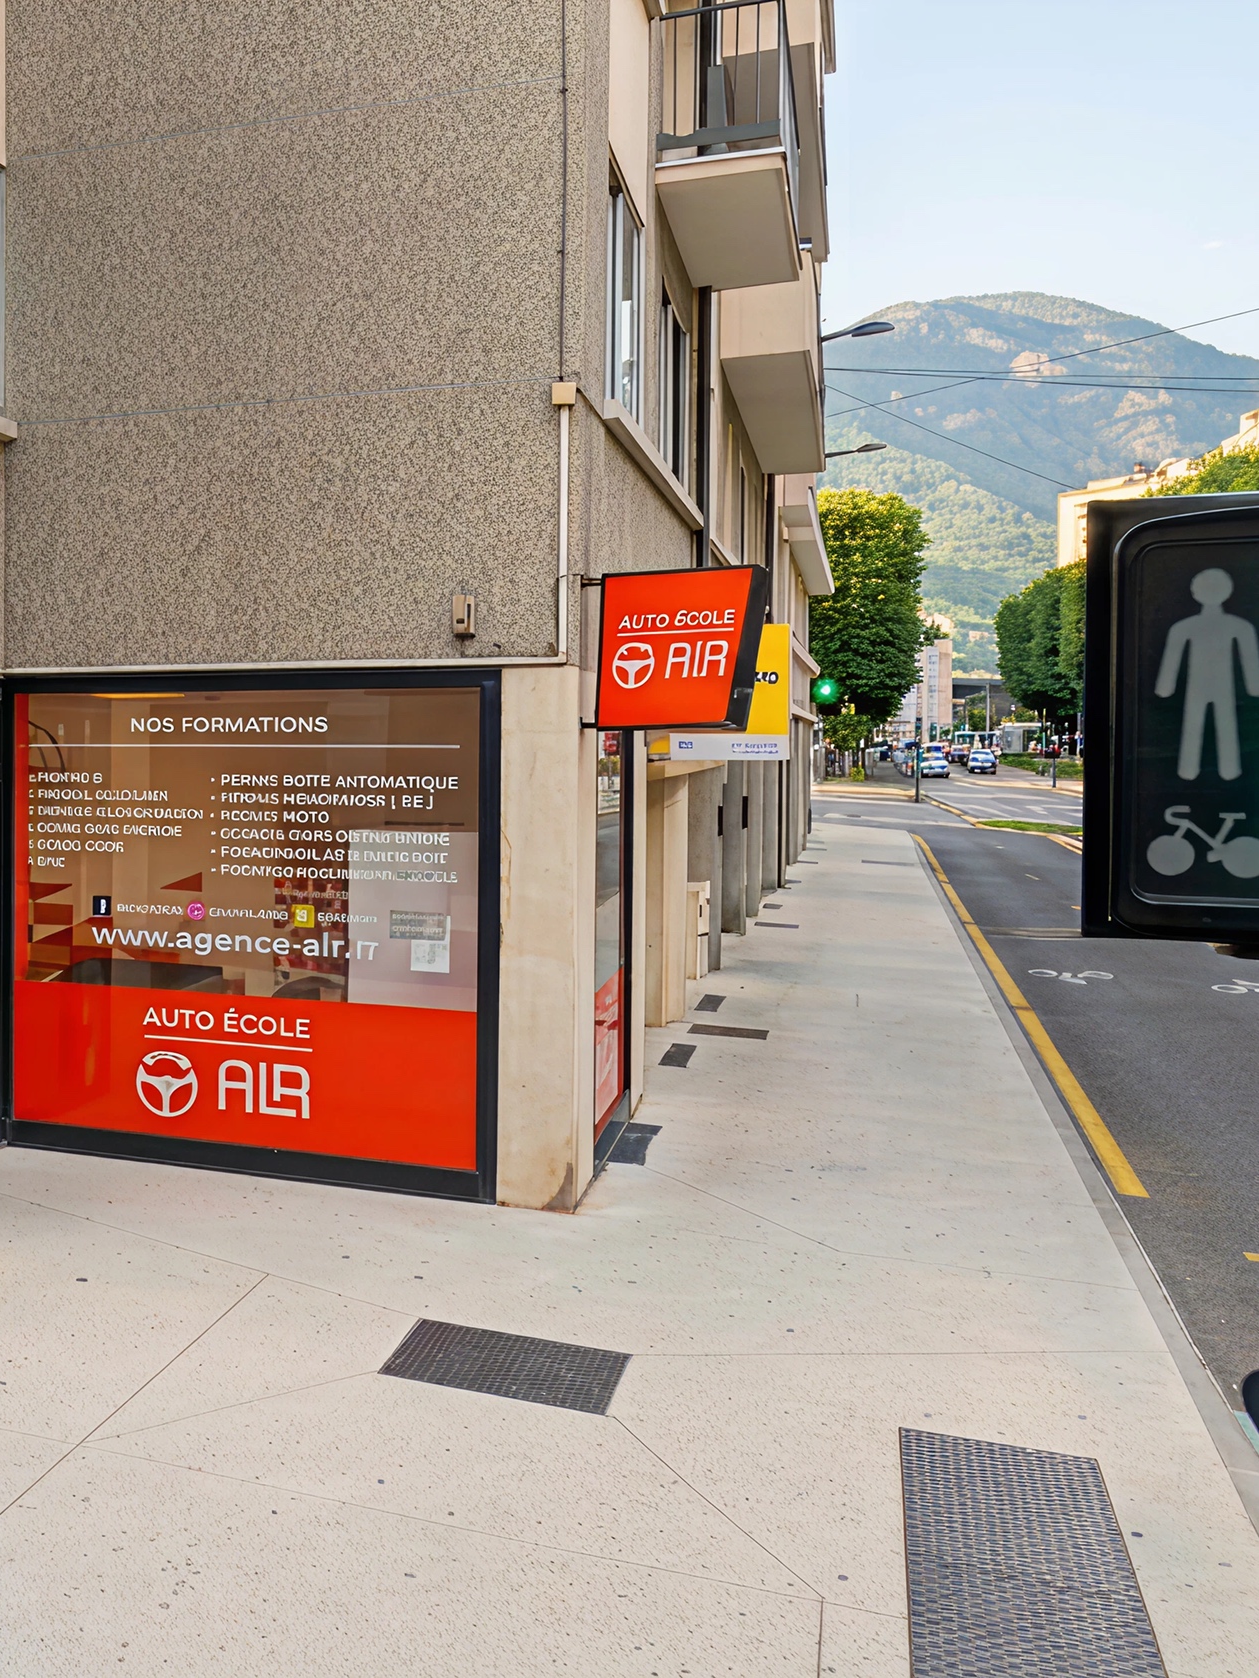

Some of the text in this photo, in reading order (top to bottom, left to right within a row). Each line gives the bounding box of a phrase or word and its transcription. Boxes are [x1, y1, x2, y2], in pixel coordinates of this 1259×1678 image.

[619, 614, 669, 630] AUTO
[664, 640, 729, 679] AIR
[131, 716, 329, 733] NOS FORMATIONS
[283, 811, 330, 823] MOTO
[143, 1006, 310, 1039] AUTO ÉCOLE
